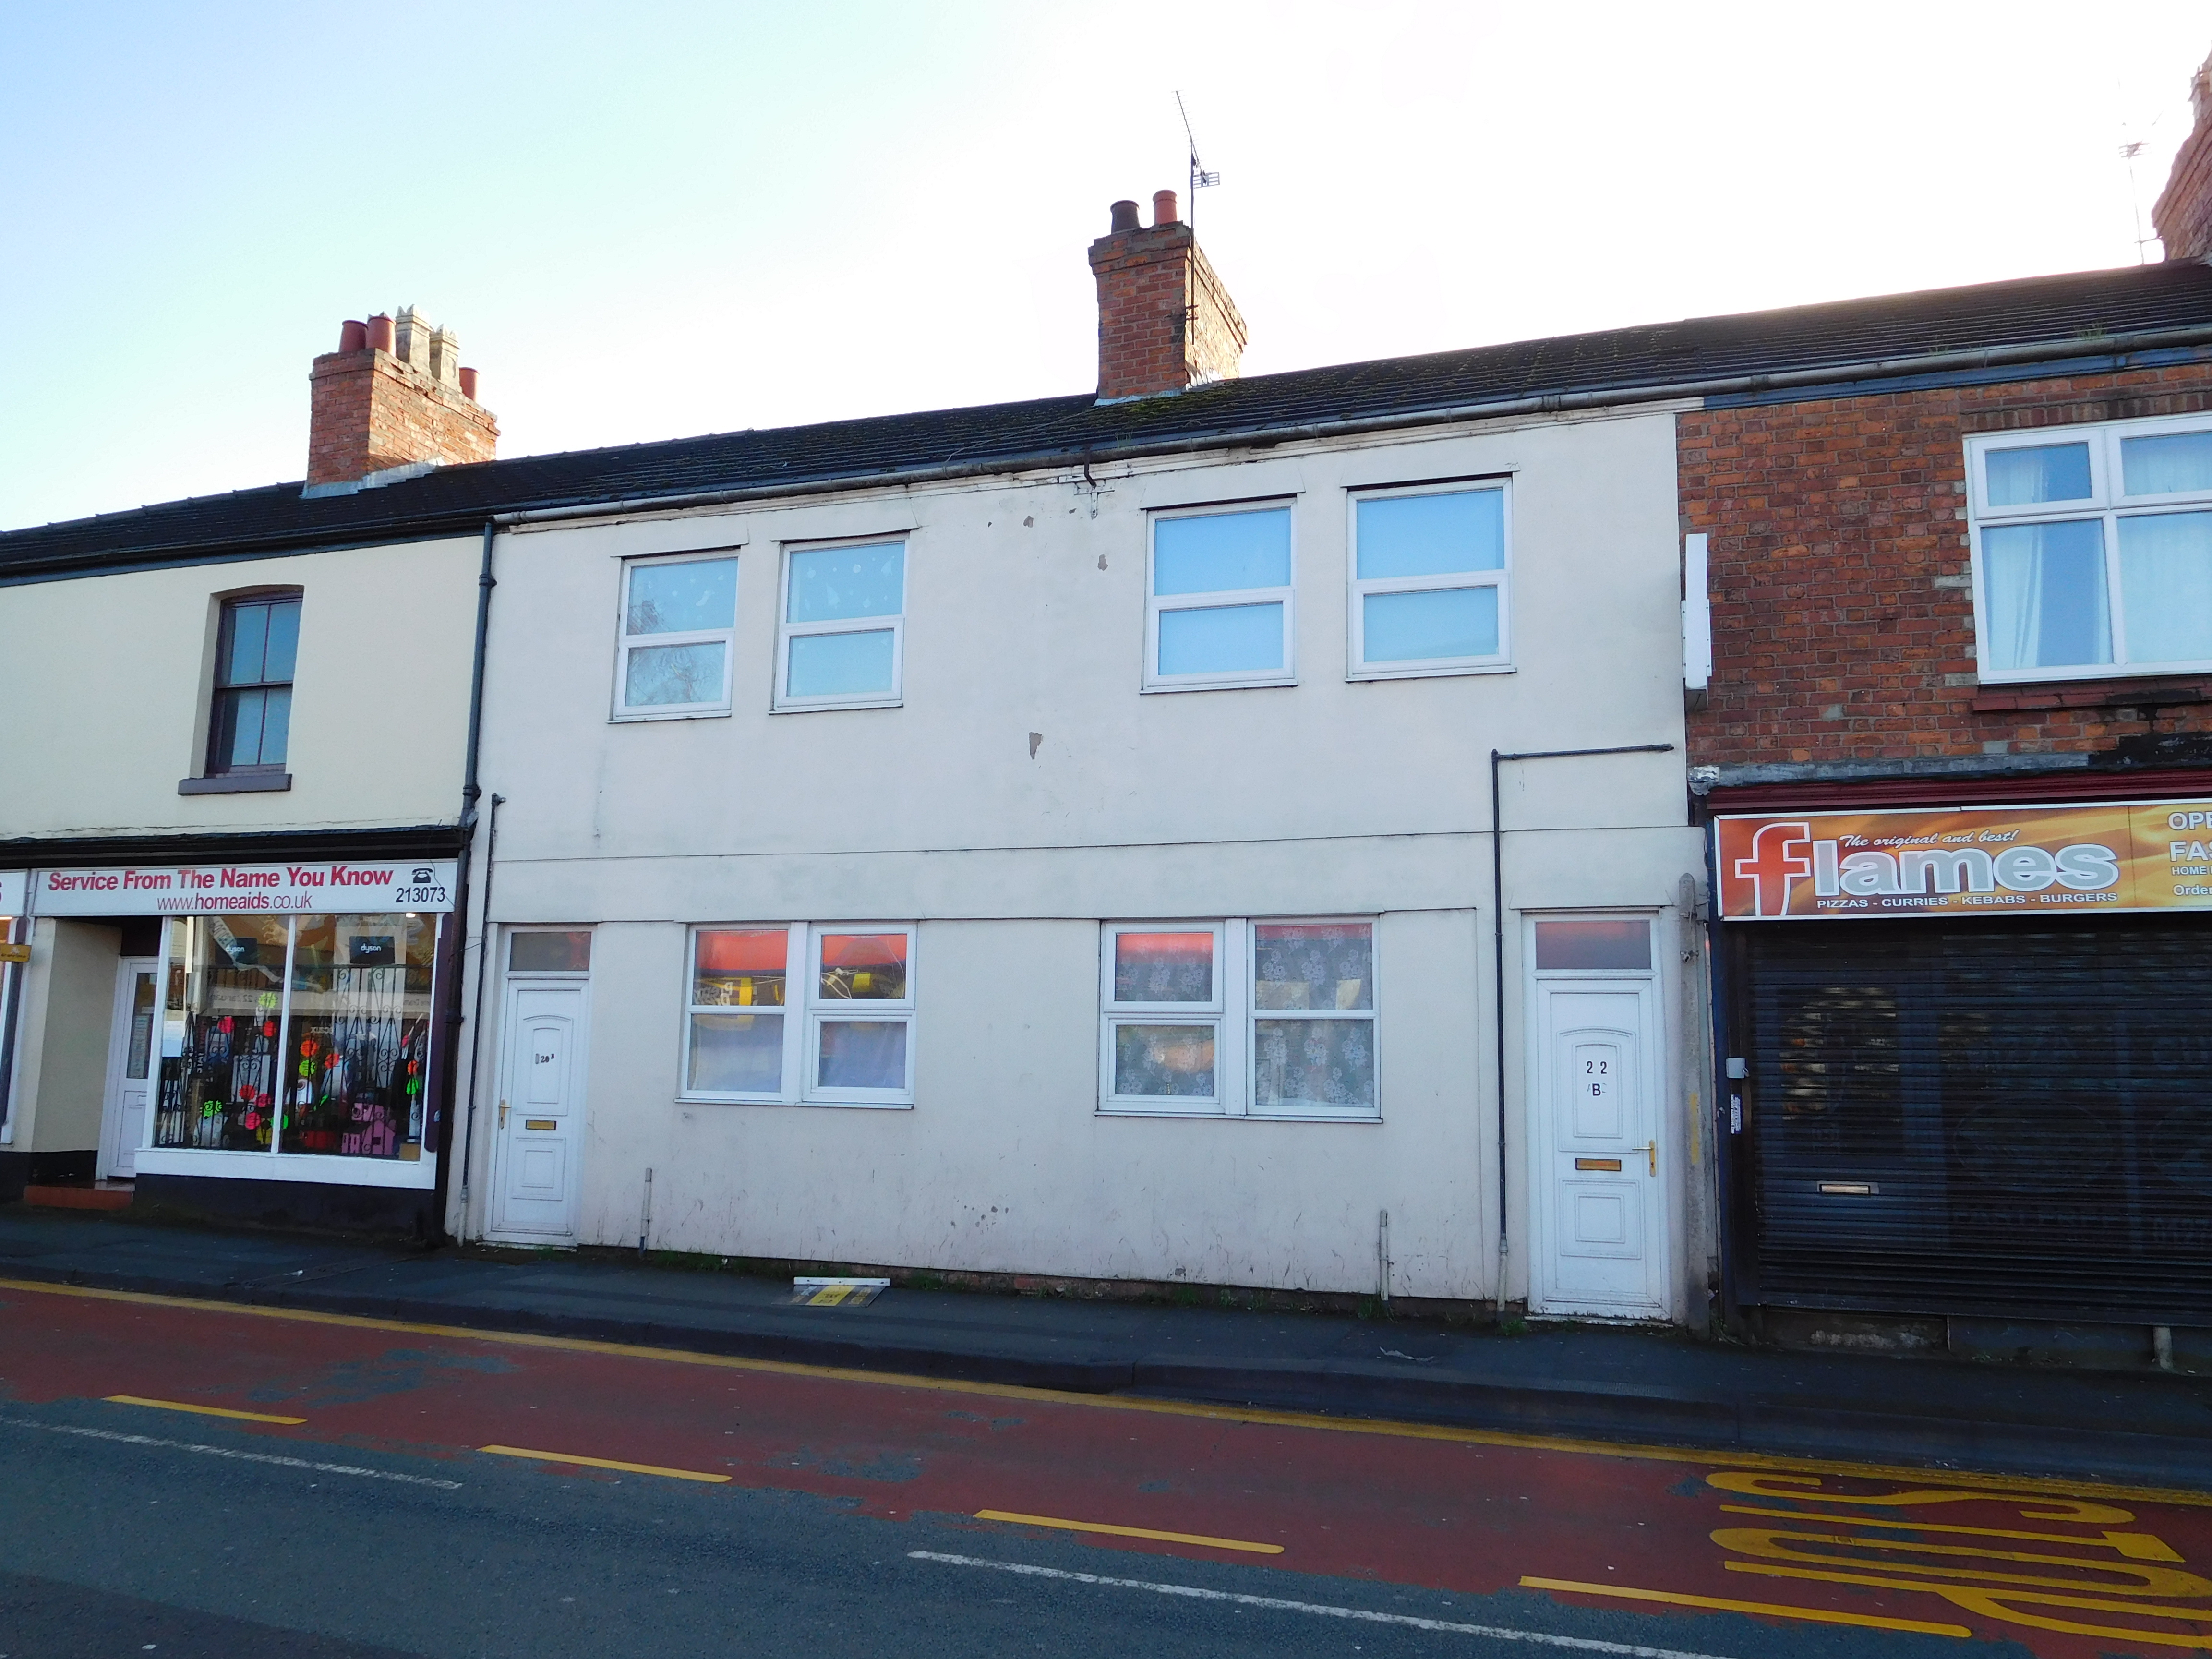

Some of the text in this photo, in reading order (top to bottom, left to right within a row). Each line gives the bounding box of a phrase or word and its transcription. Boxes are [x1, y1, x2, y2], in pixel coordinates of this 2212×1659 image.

[1839, 830, 2020, 849] The original and best!
[2169, 840, 2212, 862] FA
[1734, 822, 2119, 916] flames
[2171, 866, 2207, 876] HOME
[48, 866, 394, 891] Service From The Name You Know
[157, 891, 313, 910] www.homeaids.co.uk
[395, 886, 445, 903] 213073
[1817, 899, 1869, 908] PIZZAS
[1881, 897, 1948, 907] CURRIES
[1962, 895, 2026, 905] KEBABS
[2040, 893, 2118, 903] BURGERS
[226, 945, 245, 954] dyson
[361, 943, 381, 953] dyson
[1592, 1083, 1601, 1096] B
